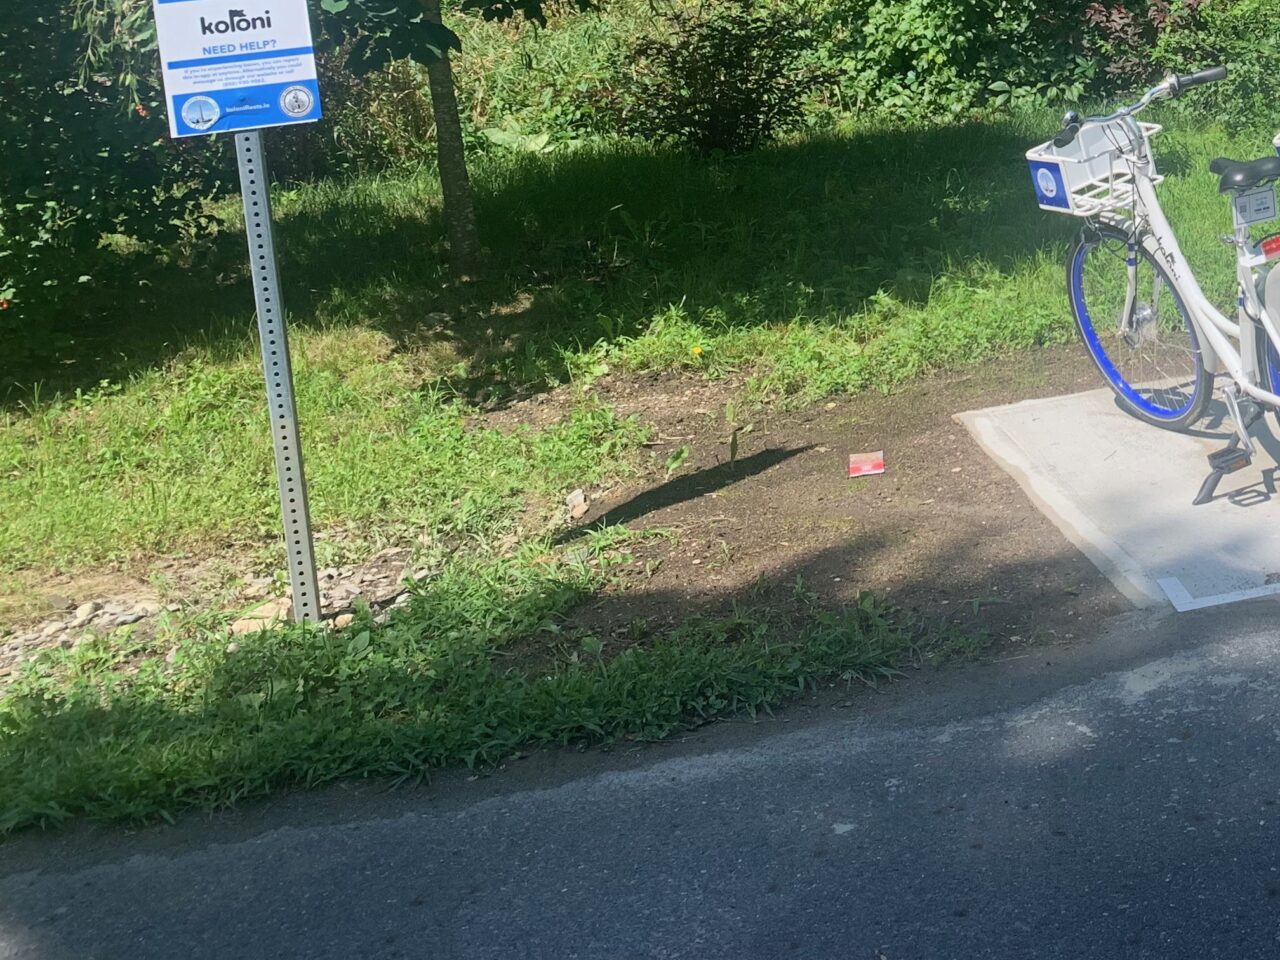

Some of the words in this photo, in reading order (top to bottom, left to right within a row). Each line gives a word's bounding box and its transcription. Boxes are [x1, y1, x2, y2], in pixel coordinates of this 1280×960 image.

[200, 9, 272, 35] koloni
[202, 43, 236, 55] NEED
[240, 39, 277, 52] HELP?
